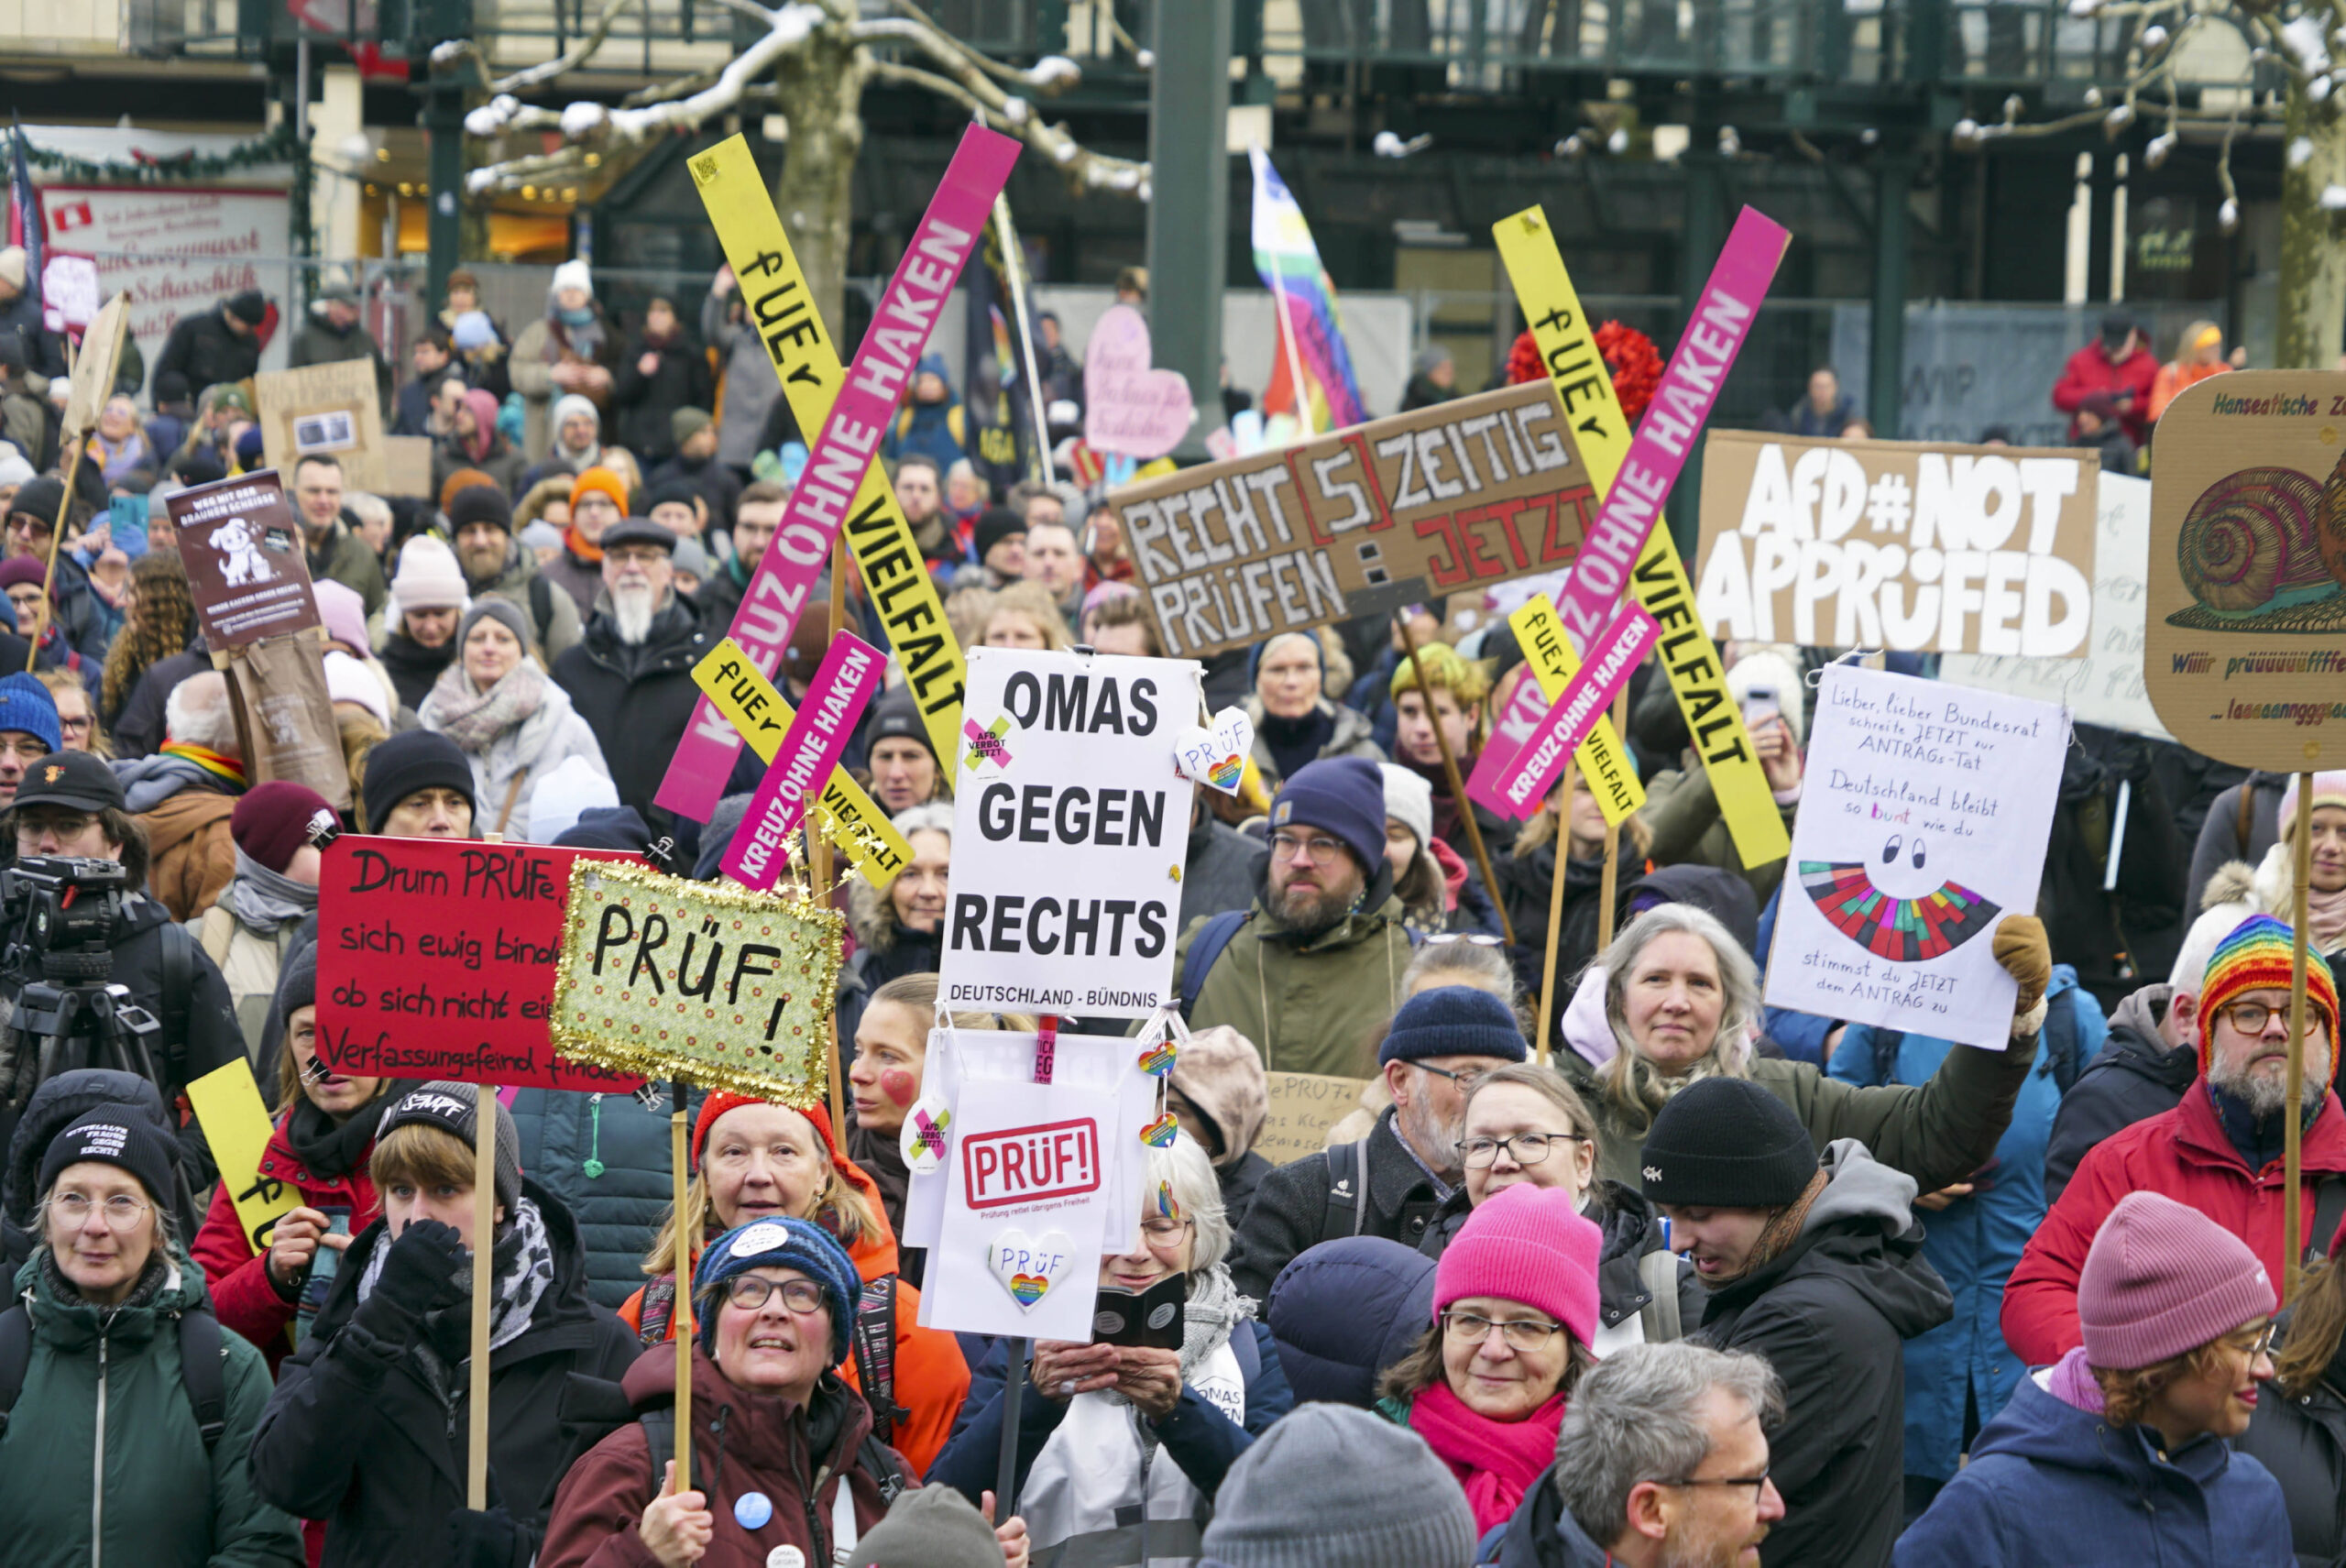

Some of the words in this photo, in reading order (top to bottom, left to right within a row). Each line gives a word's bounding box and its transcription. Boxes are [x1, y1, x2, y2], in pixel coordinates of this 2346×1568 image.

[2212, 391, 2319, 416] Hanseatische
[1575, 460, 1666, 597] OHNE
[1643, 288, 1751, 457] HAKEN
[216, 491, 235, 503] MIT
[694, 570, 806, 749] KEUZ
[778, 413, 878, 567] OHNE
[852, 219, 972, 400] HAKEN
[1150, 549, 1351, 657] PRÜFEN
[1412, 486, 1597, 587] JETZT
[1695, 529, 2092, 657] APPRÜFED
[848, 495, 965, 716] VIELFALT
[1634, 548, 1749, 768] VIELFALT
[1003, 671, 1158, 737] OMAS
[1506, 738, 1559, 806] KREUZ
[1557, 681, 1601, 741] OHNE
[1597, 614, 1650, 688] HAKEN
[1831, 685, 1880, 714] Lieber,
[1885, 692, 1932, 720] lieber
[1945, 702, 2041, 739] Bundesrat
[969, 739, 1006, 750] VERBOT
[974, 749, 1002, 759] JETZT
[977, 731, 996, 740] AFD
[1185, 720, 1244, 771] PRÜF
[1913, 724, 1968, 746] JETZT
[1974, 740, 1996, 751] zur
[739, 788, 803, 880] KREUZ
[789, 731, 827, 803] OHNE
[815, 647, 872, 736] HAKEN
[1584, 729, 1634, 813] VIELFALT
[979, 782, 1166, 848] GEGEN
[1828, 769, 1941, 806] Deutschland
[1950, 789, 1999, 817] bleibt
[1844, 801, 1862, 814] so
[1871, 802, 1911, 824] bunt
[1922, 818, 1946, 833] wie
[1954, 821, 1974, 838] du
[349, 850, 448, 896] Drum
[340, 920, 405, 955] sich
[418, 927, 481, 970] ewig
[950, 893, 1168, 959] RECHTS
[592, 905, 786, 1055] PRÜF!
[950, 983, 1074, 1006] DEUTSCHLAND
[1087, 985, 1158, 1008] BÜNDNIS
[1803, 949, 1871, 977] stimmst
[1881, 970, 1901, 983] du
[1908, 970, 1959, 992] JETZT
[332, 980, 367, 1007] ob
[379, 983, 435, 1017] sich
[443, 991, 509, 1019] nicht
[1816, 978, 1845, 994] dem
[1849, 981, 1924, 1010] ANTRAG
[1931, 1001, 1948, 1014] zu
[321, 1025, 536, 1078] Verfassungsfeind
[91, 1137, 126, 1148] GEGEN
[916, 1131, 946, 1139] VERBOT
[975, 1131, 1088, 1196] PRÜF!
[1031, 1201, 1062, 1212] übrigens
[1063, 1197, 1091, 1208] Freiheit
[1001, 1247, 1065, 1275] PRÜF
